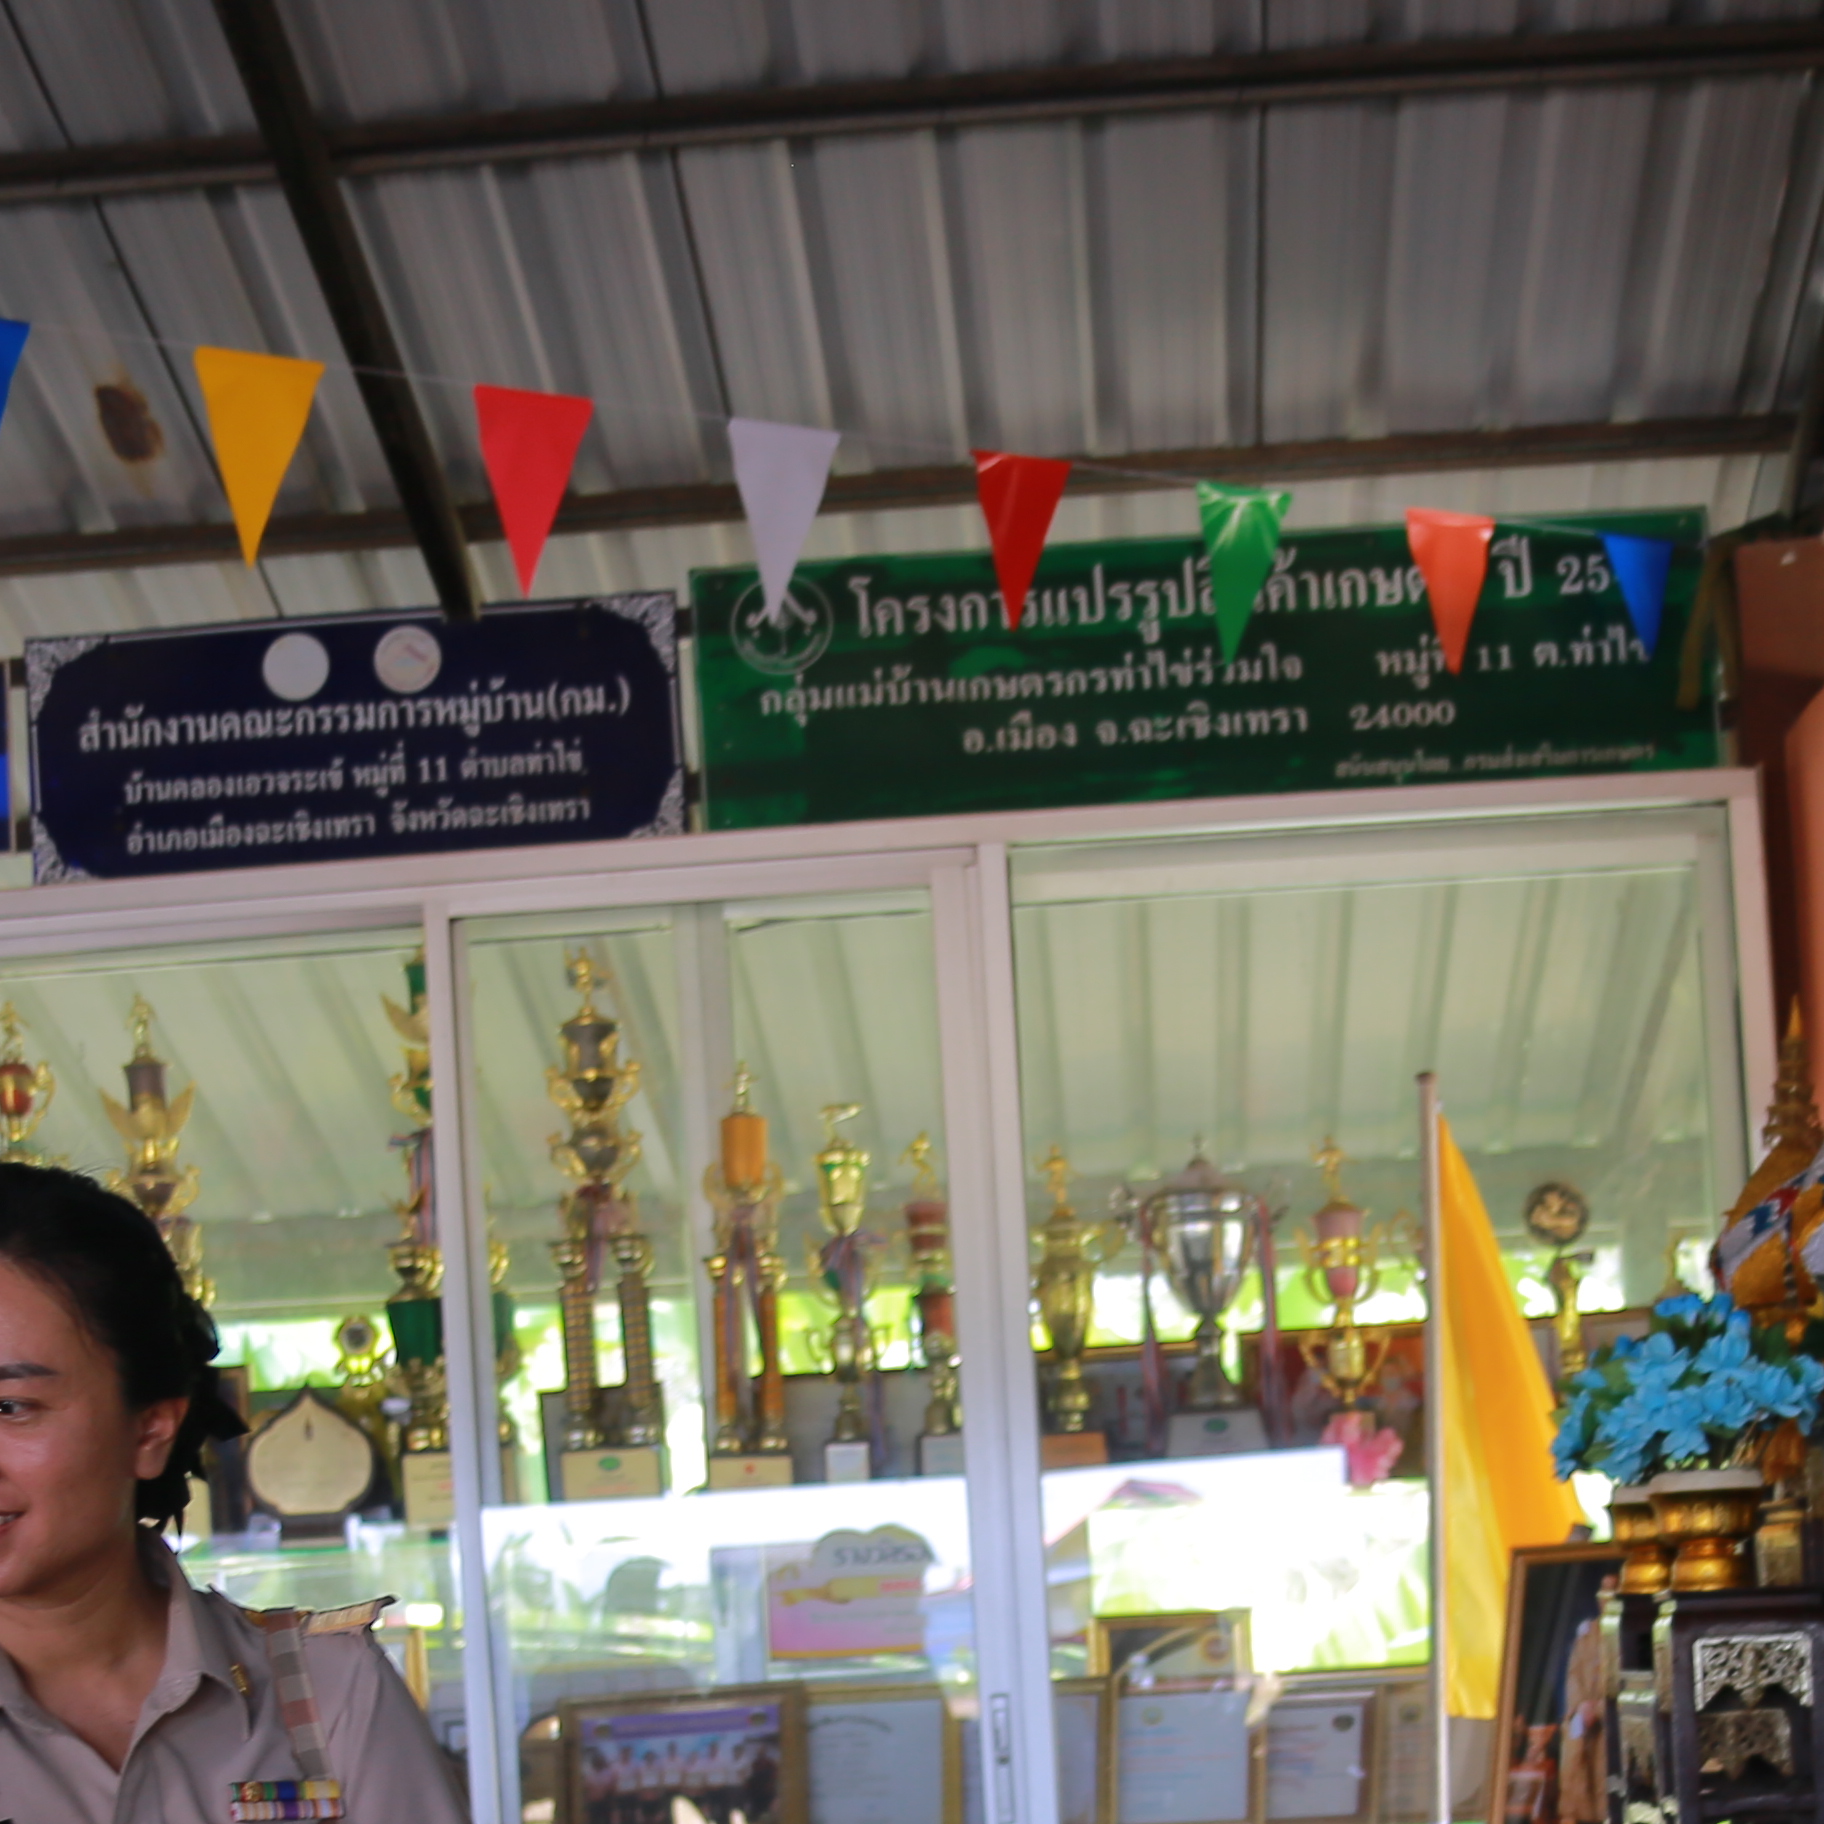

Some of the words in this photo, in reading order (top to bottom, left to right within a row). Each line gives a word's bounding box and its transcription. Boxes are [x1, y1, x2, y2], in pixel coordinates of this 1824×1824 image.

[1491, 534, 1533, 600] ปี
[1478, 644, 1514, 672] 11
[962, 710, 1078, 755] อ.เมือง
[1095, 698, 1308, 748] จ.ฉะเชิงเทรา
[1348, 700, 1457, 732] 24000
[351, 741, 407, 797] หมู่ที่
[418, 754, 448, 784] 11
